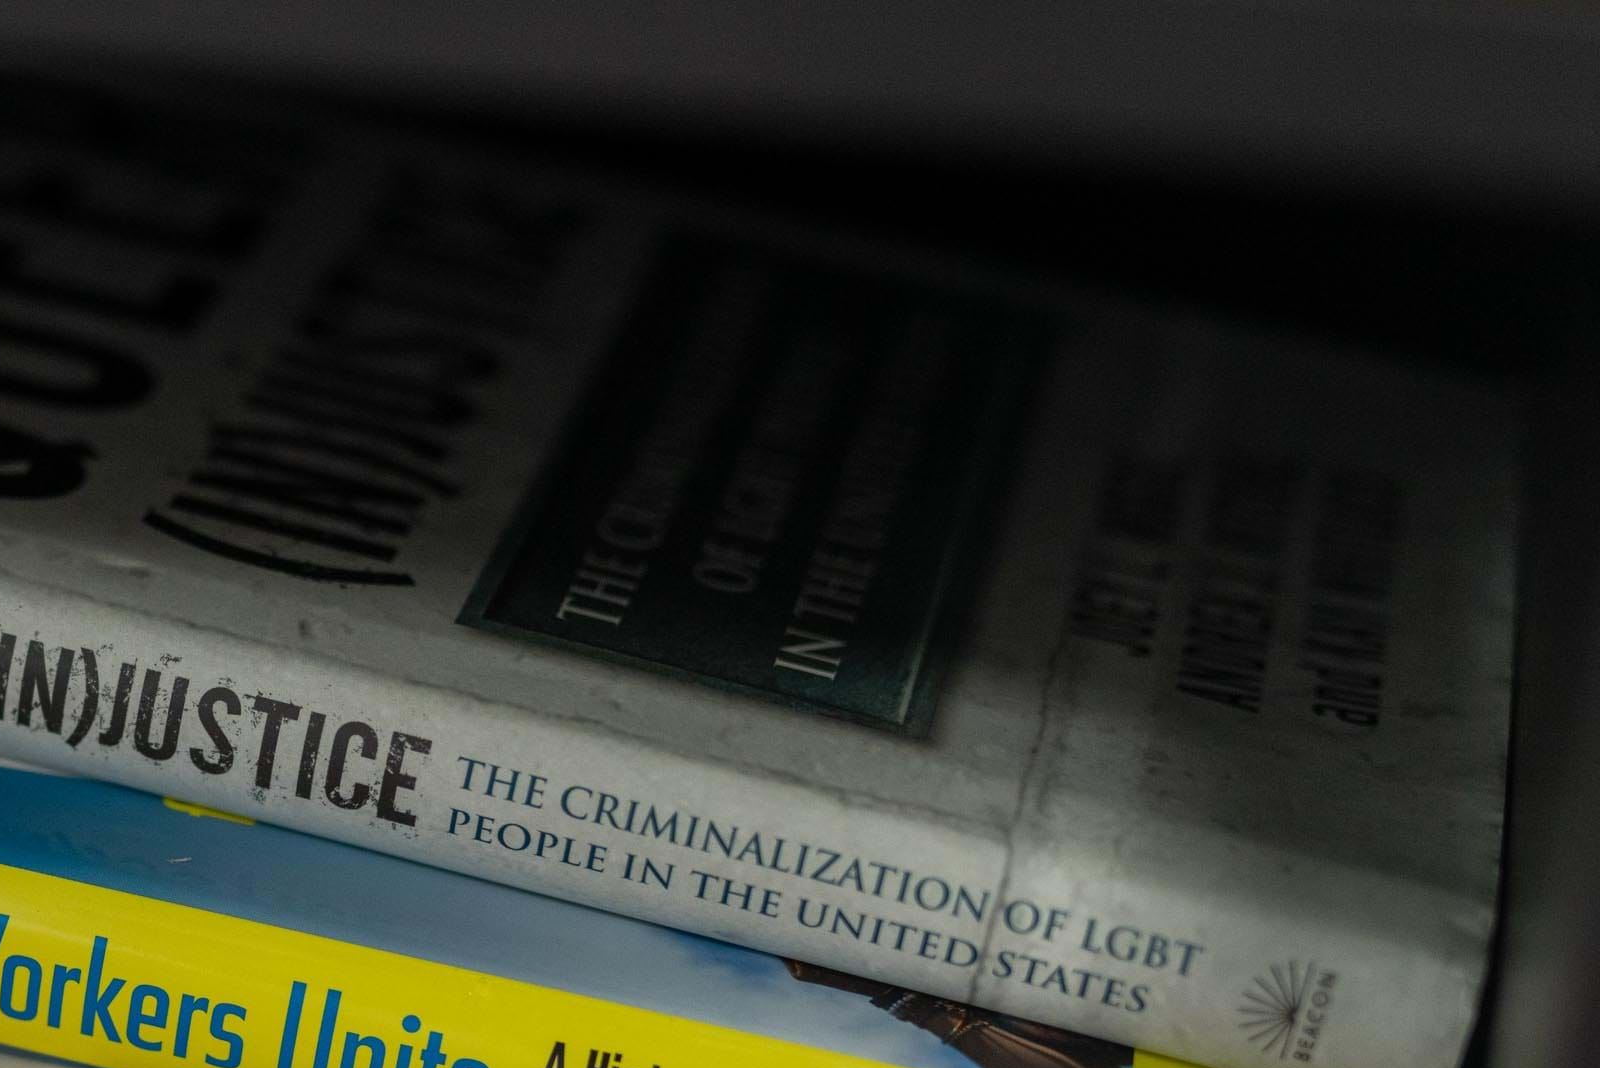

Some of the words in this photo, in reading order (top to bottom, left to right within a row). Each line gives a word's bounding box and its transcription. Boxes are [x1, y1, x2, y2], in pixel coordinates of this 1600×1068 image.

[774, 620, 848, 682] IN
[445, 806, 607, 875] PEOPLE
[619, 852, 677, 890] IN
[688, 869, 782, 918] THE
[794, 896, 981, 972] UNITED
[992, 948, 1150, 1014] STATES
[456, 756, 548, 808] THE
[559, 783, 992, 926] CRIMINALIZATION
[1002, 896, 1067, 942] OF
[1082, 915, 1206, 980] LGBT
[1292, 969, 1338, 1064] BEACON
